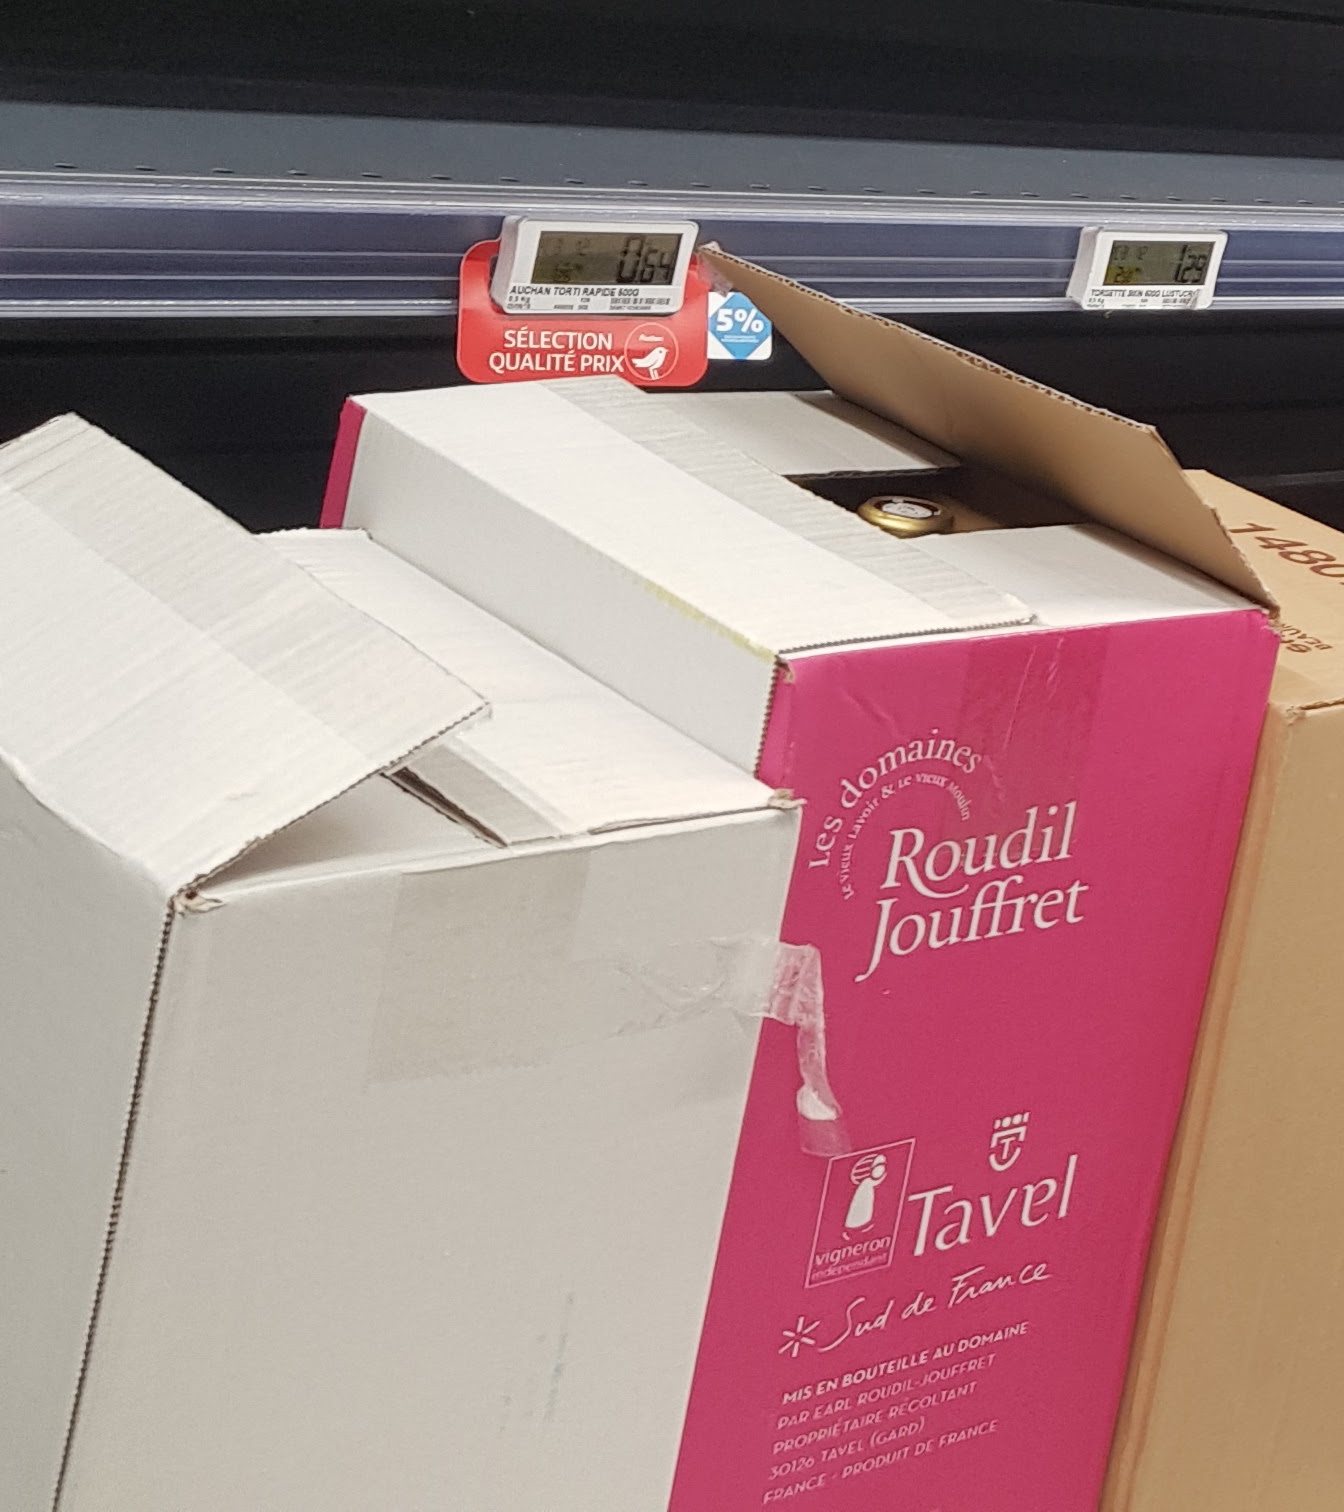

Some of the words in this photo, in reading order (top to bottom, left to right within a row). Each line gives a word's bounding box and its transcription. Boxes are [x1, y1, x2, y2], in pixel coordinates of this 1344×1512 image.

[509, 285, 552, 296] AUCHAN
[553, 286, 580, 296] TORTI
[581, 287, 617, 297] RAPIDE
[716, 308, 764, 334] 5%
[489, 349, 575, 373] QUALITÉ
[580, 355, 625, 373] PRIX
[504, 326, 612, 351] SÉLECTION
[809, 816, 844, 869] Les
[840, 728, 982, 809] domaines
[880, 800, 1077, 899] Roudil
[854, 875, 1090, 983] Jouffret
[907, 1154, 1079, 1257] Tavel
[814, 1235, 892, 1267] vigneron
[818, 1297, 894, 1352] Sud
[901, 1292, 936, 1321] de
[948, 1262, 1054, 1310] France
[776, 1408, 809, 1430] PAR
[812, 1398, 852, 1420] EARL
[857, 1353, 998, 1408] ROUDIL-JOUFFRET
[782, 1384, 812, 1405] MIS
[815, 1377, 839, 1396] EN
[841, 1350, 930, 1390] BOUTEILLE
[932, 1343, 955, 1361] AU
[956, 1320, 1030, 1353] DOMAINE
[762, 1473, 826, 1505] FRANCE
[842, 1445, 912, 1479] PRODUIT
[914, 1437, 934, 1456] DE
[938, 1418, 1000, 1448] FRANCE
[769, 1457, 816, 1481] 30126
[820, 1440, 865, 1463] TAVEL
[869, 1416, 926, 1449] (GARD)
